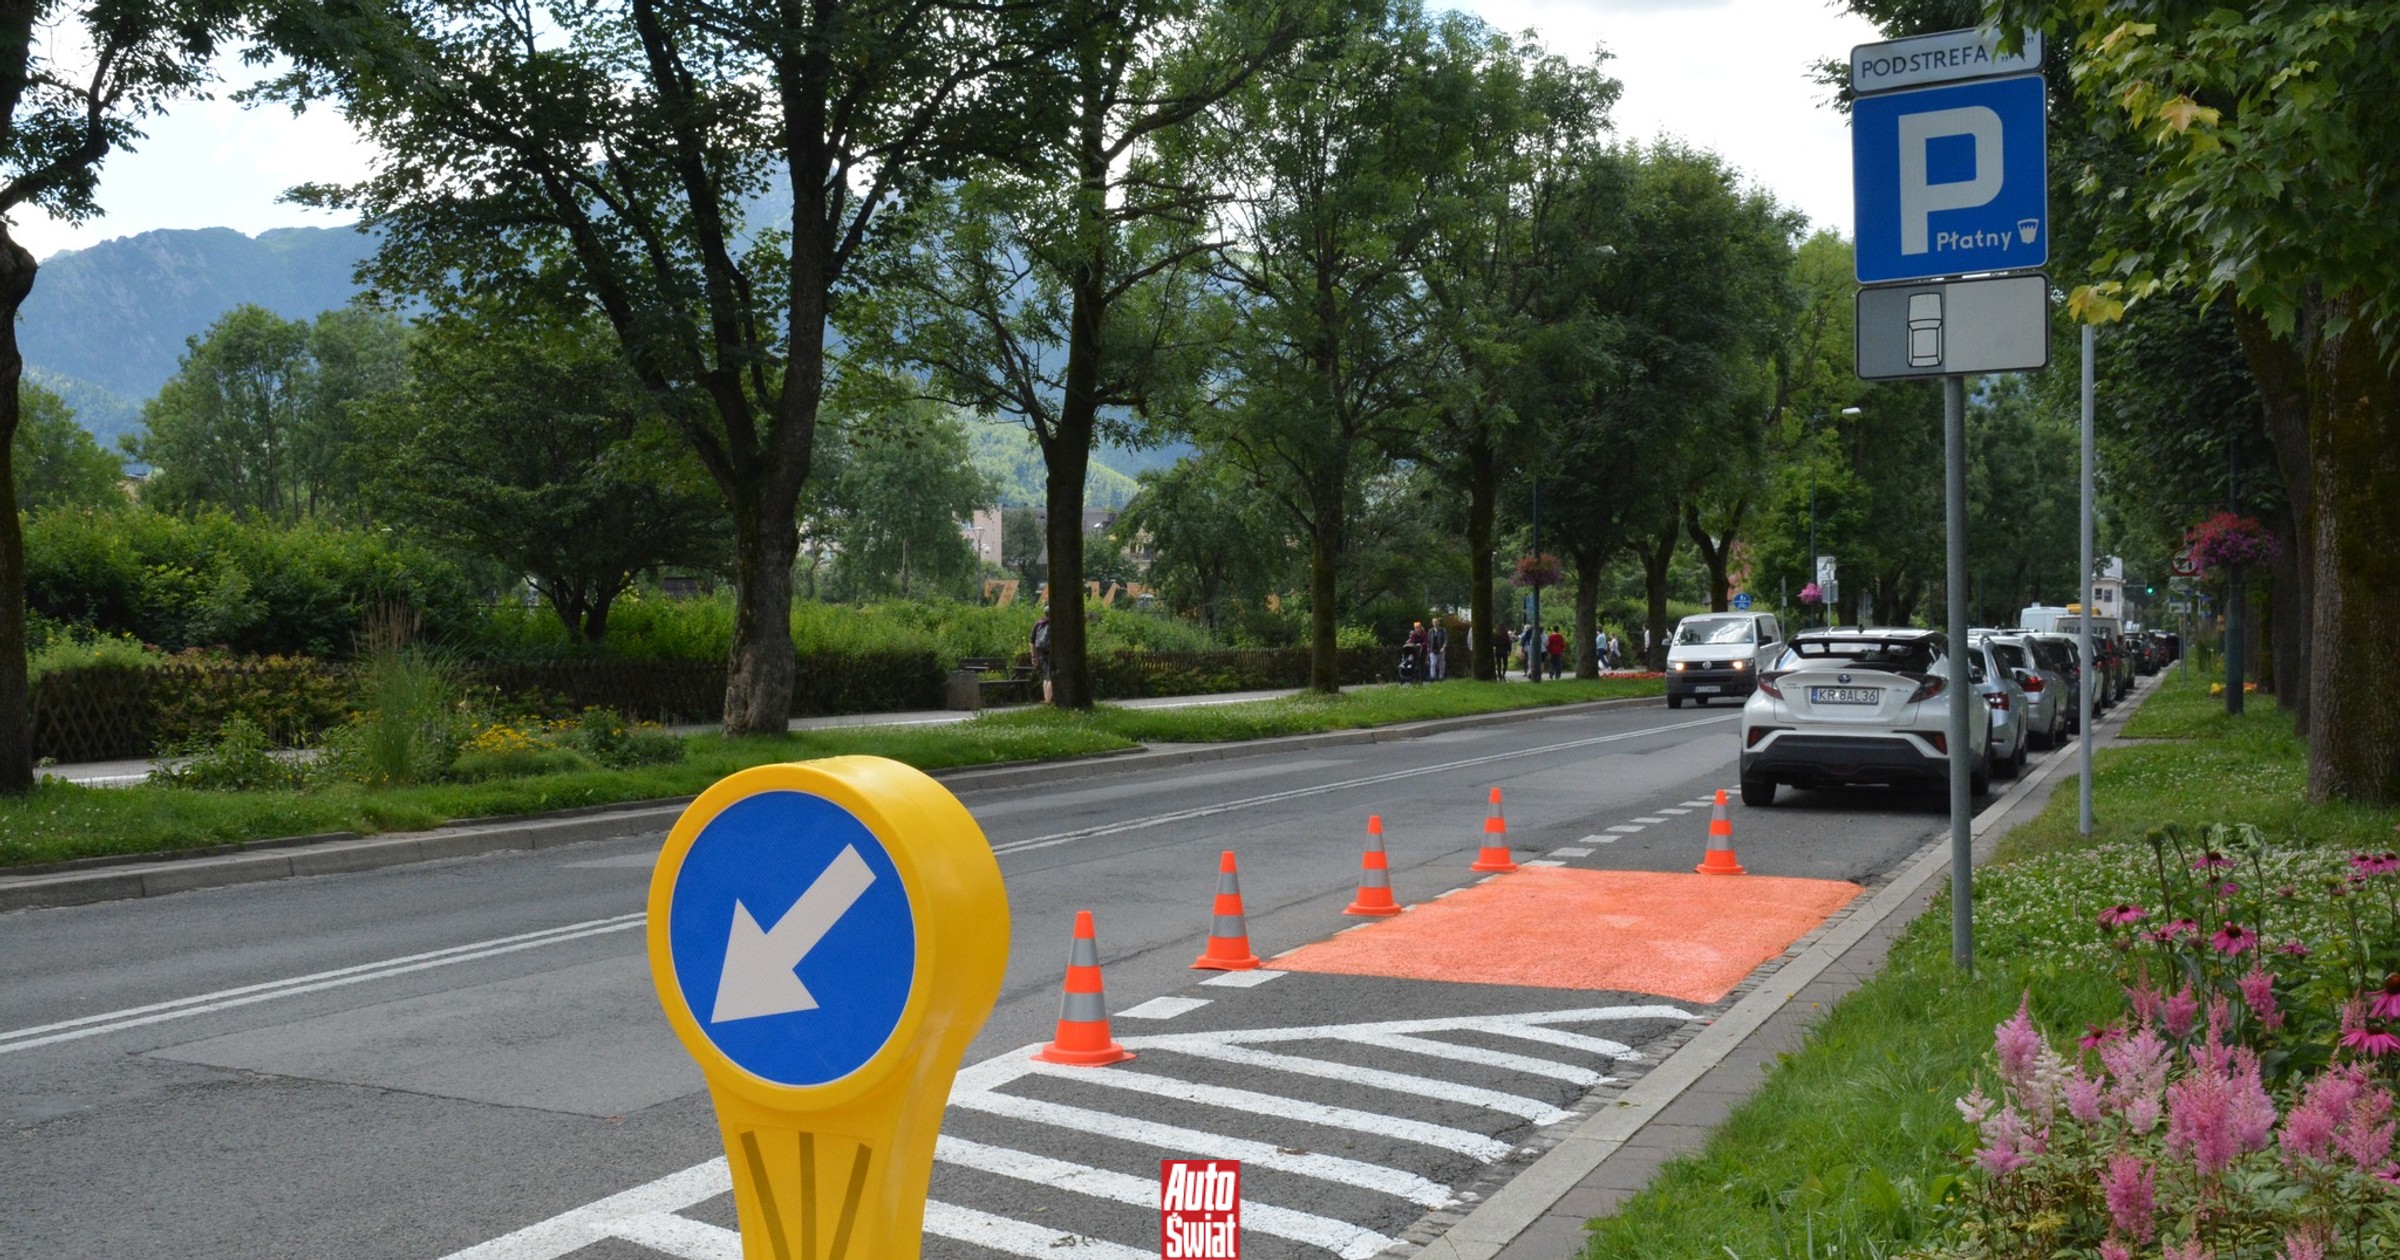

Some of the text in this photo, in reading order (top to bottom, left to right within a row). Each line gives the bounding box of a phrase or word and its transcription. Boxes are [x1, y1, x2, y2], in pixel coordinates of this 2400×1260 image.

[1862, 44, 1988, 78] PODSTREFA
[1898, 105, 2004, 256] P
[1937, 229, 2012, 251] Płatny
[1818, 688, 1836, 701] KR
